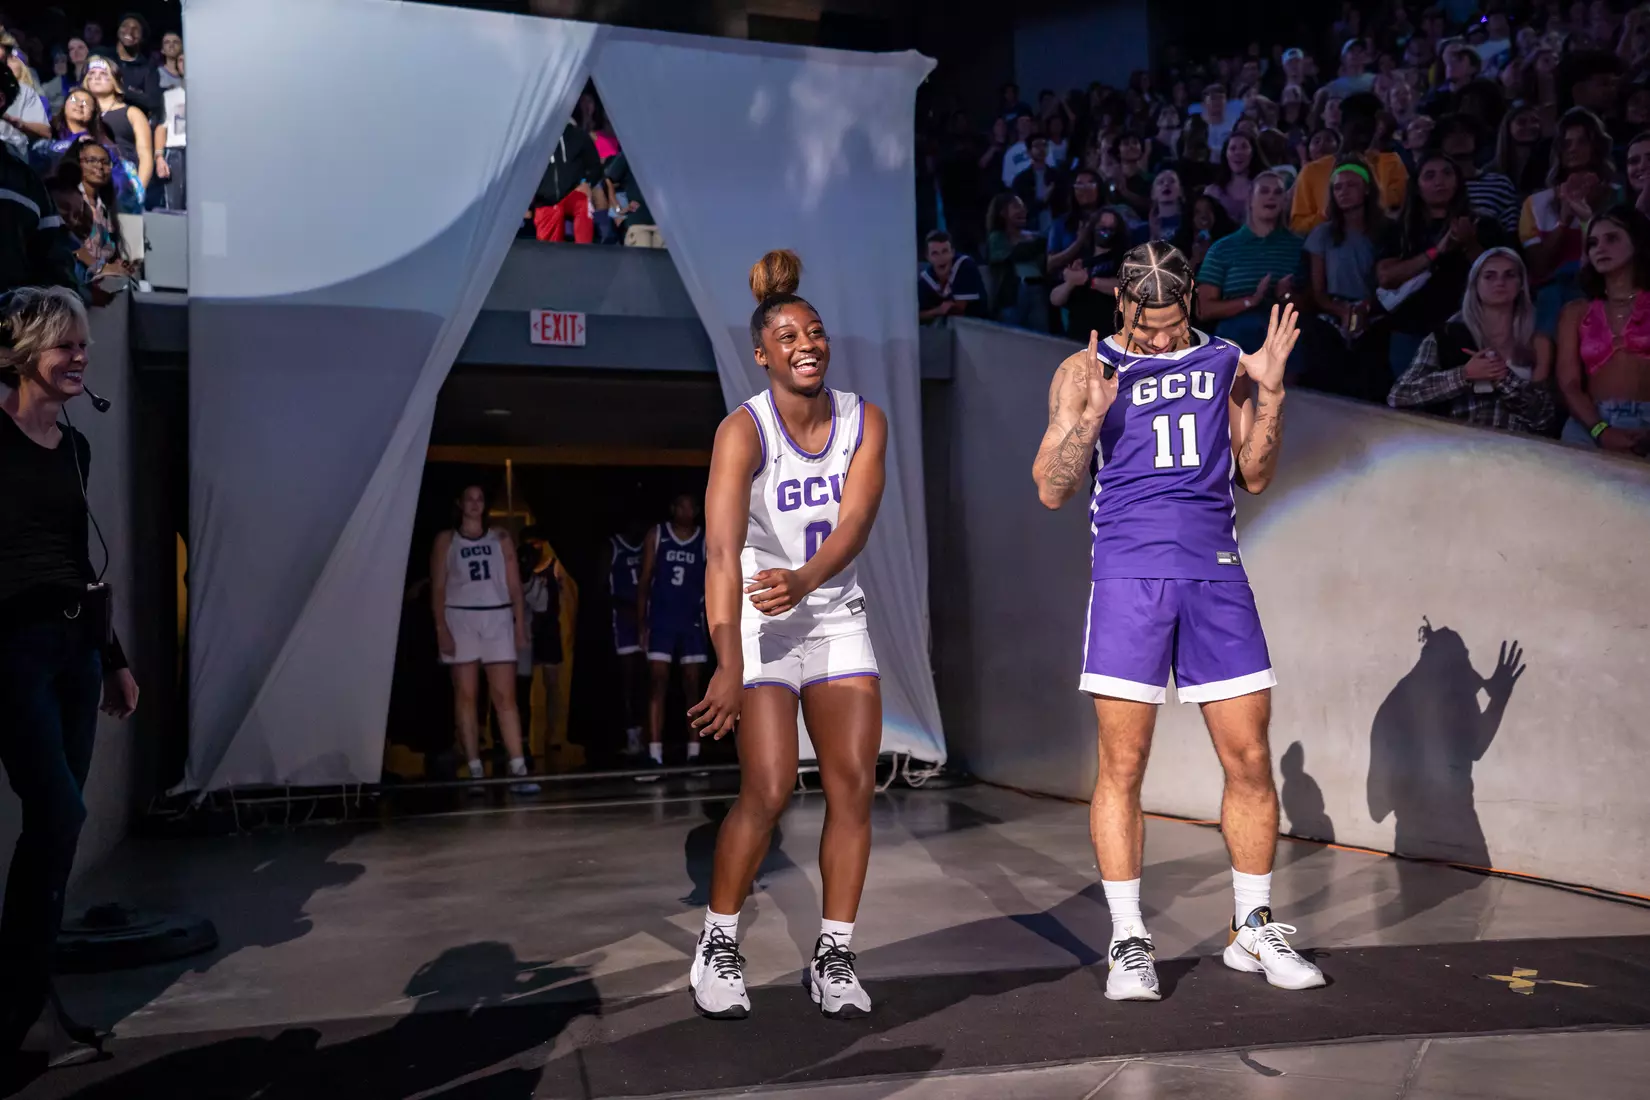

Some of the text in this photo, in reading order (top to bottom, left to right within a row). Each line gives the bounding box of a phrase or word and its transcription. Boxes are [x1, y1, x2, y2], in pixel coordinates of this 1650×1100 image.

[541, 312, 578, 343] EXIT
[1132, 371, 1215, 406] GCU
[1152, 413, 1201, 469] 11
[461, 545, 491, 558] GCU
[666, 550, 695, 564] GCU
[469, 560, 491, 581] 21
[671, 566, 685, 586] 3
